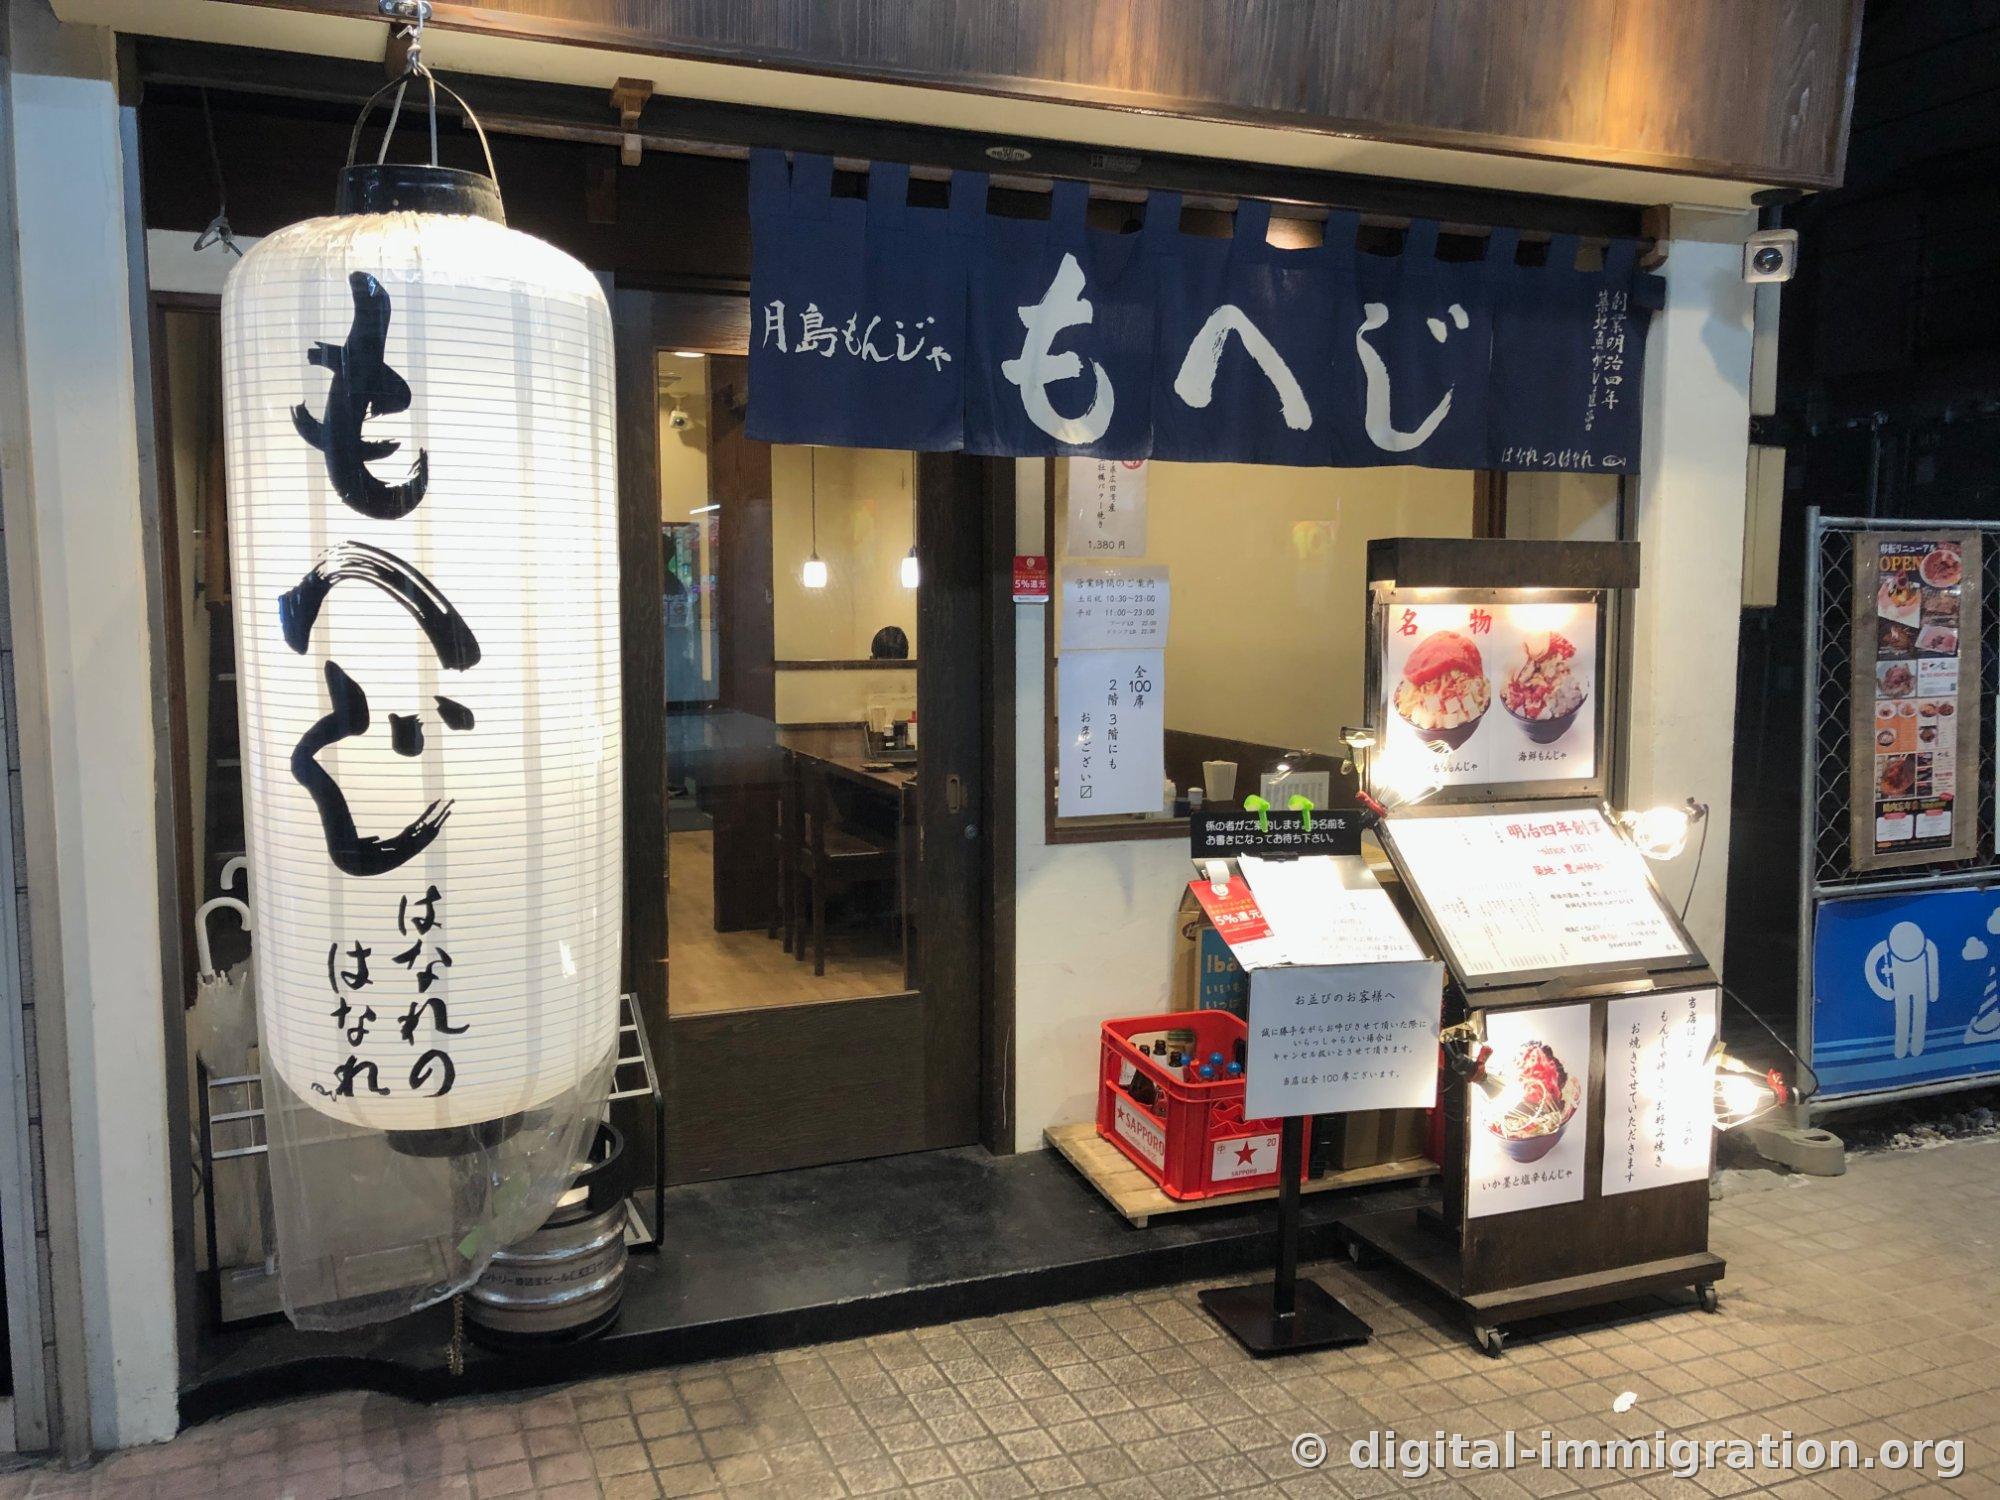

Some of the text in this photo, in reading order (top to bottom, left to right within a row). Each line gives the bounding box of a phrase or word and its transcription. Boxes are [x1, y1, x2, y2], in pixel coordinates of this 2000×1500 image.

[763, 300, 952, 372] 月島もんじゃ
[1001, 252, 1470, 453] もへじ
[277, 271, 482, 877] もへじ
[1879, 556, 1923, 572] OPEN
[1396, 608, 1493, 637] 名物
[1205, 833, 1335, 846] お書きになってお待ち下さい。
[393, 885, 471, 1098] はなれの
[1295, 989, 1397, 1006] お並びのお客様へ
[1125, 1112, 1164, 1156] SAPPORO
[1266, 1138, 1277, 1147] 20
[1231, 1168, 1258, 1177] SAPPORO
